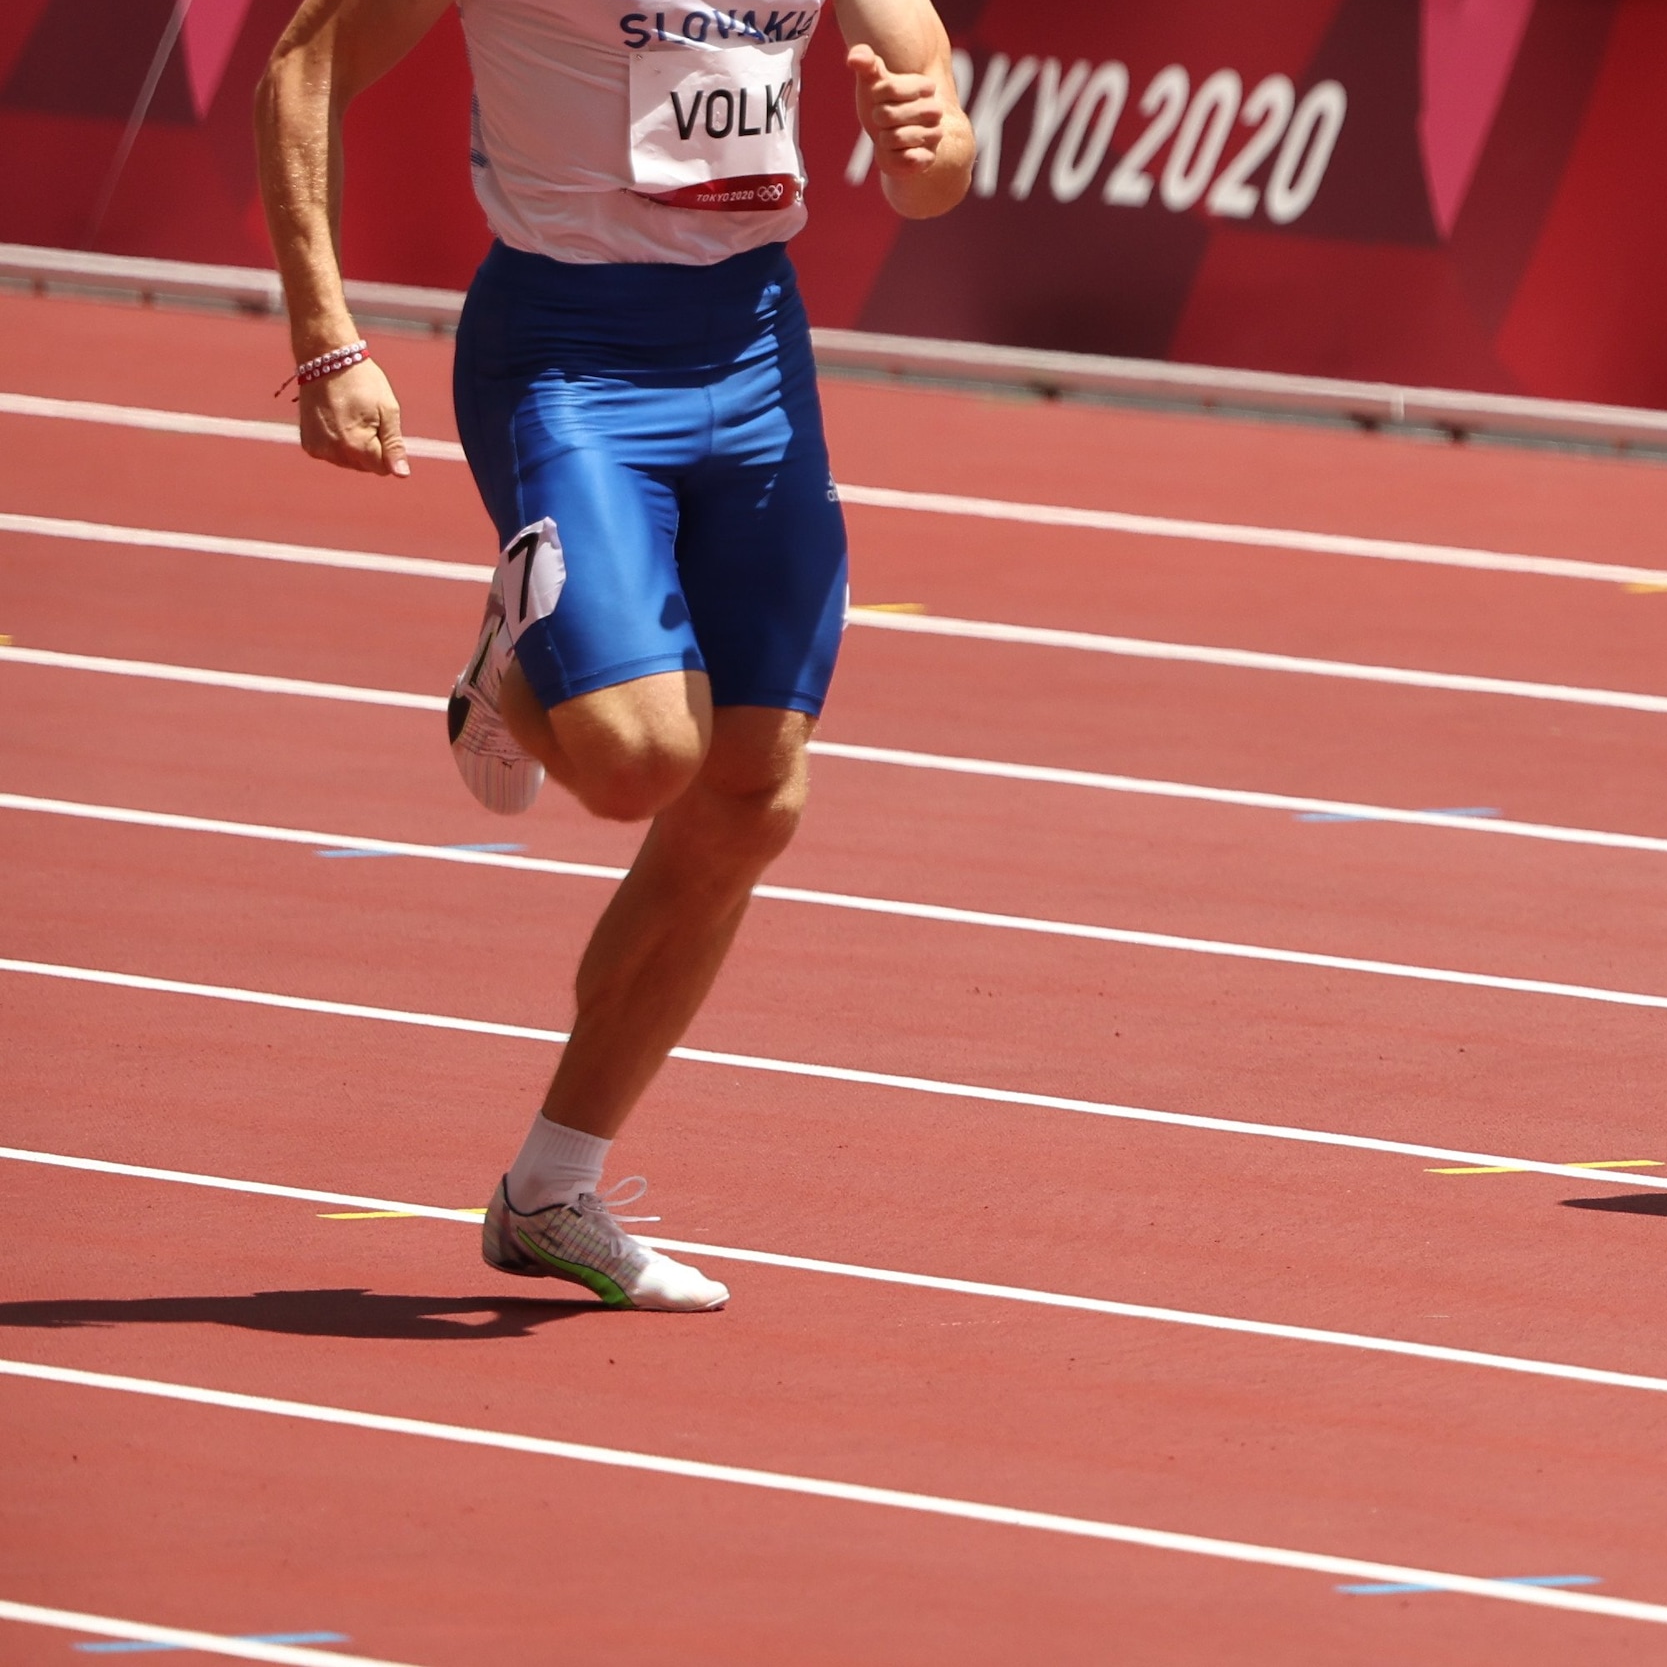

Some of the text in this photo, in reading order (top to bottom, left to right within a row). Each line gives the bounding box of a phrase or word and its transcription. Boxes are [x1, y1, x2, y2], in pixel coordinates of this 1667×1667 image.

[845, 48, 1349, 226] KYO 2020
[696, 191, 754, 203] TOKYO 2020
[508, 531, 541, 624] 7
